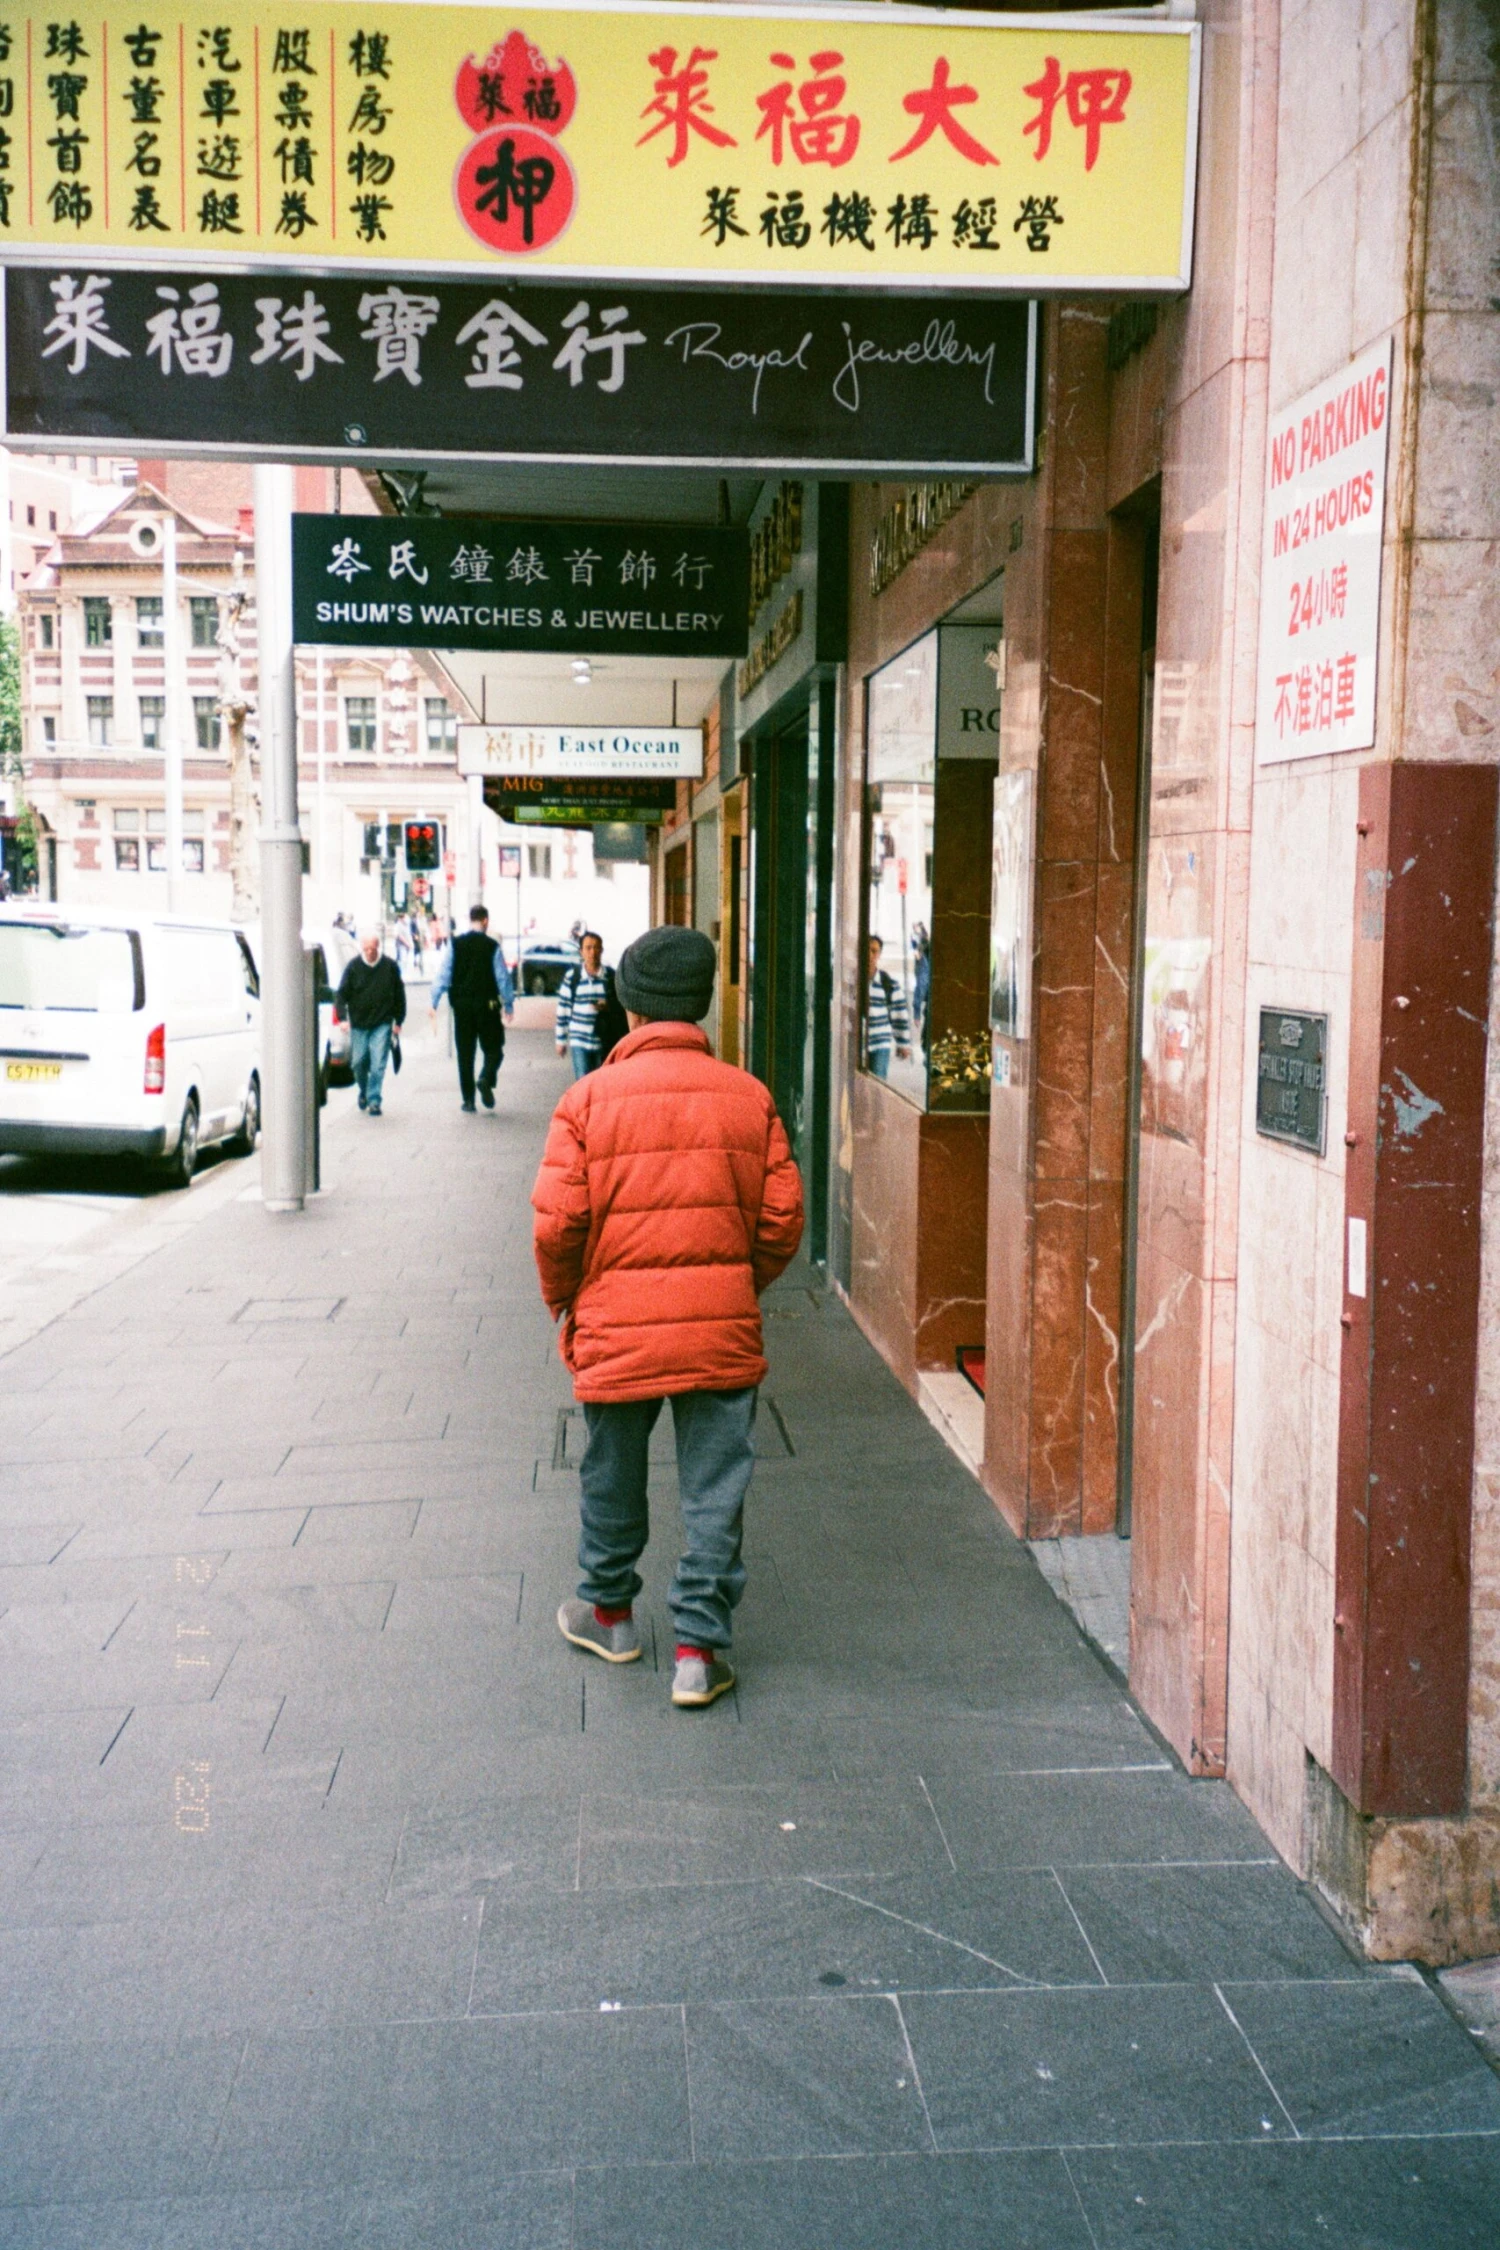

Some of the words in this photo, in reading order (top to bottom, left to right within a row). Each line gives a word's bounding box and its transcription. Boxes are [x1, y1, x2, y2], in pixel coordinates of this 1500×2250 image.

[123, 24, 171, 232] 古董名表
[197, 27, 245, 235] 汽車遊艇
[273, 29, 319, 238] 股票債券
[348, 29, 395, 243] 樓房物業
[473, 74, 561, 121] 萊福
[636, 45, 1132, 172] 萊福大押
[475, 137, 554, 245] 押
[700, 186, 1064, 252] 萊福機構經營
[665, 322, 812, 414] Royal
[1271, 426, 1295, 488] NO
[1300, 366, 1386, 473] PARKING
[1274, 518, 1288, 558] IN
[1292, 507, 1310, 549] 24
[1315, 470, 1374, 540] HOURS
[326, 537, 715, 592] 岑氏鐘錶首飾行
[1288, 562, 1348, 637] 24小時
[316, 602, 413, 625] SHUM'S
[421, 604, 542, 628] WATCHES
[551, 609, 567, 629] &
[575, 609, 724, 632] JEWELLERY
[559, 736, 607, 754] East
[613, 736, 680, 754] Ocean
